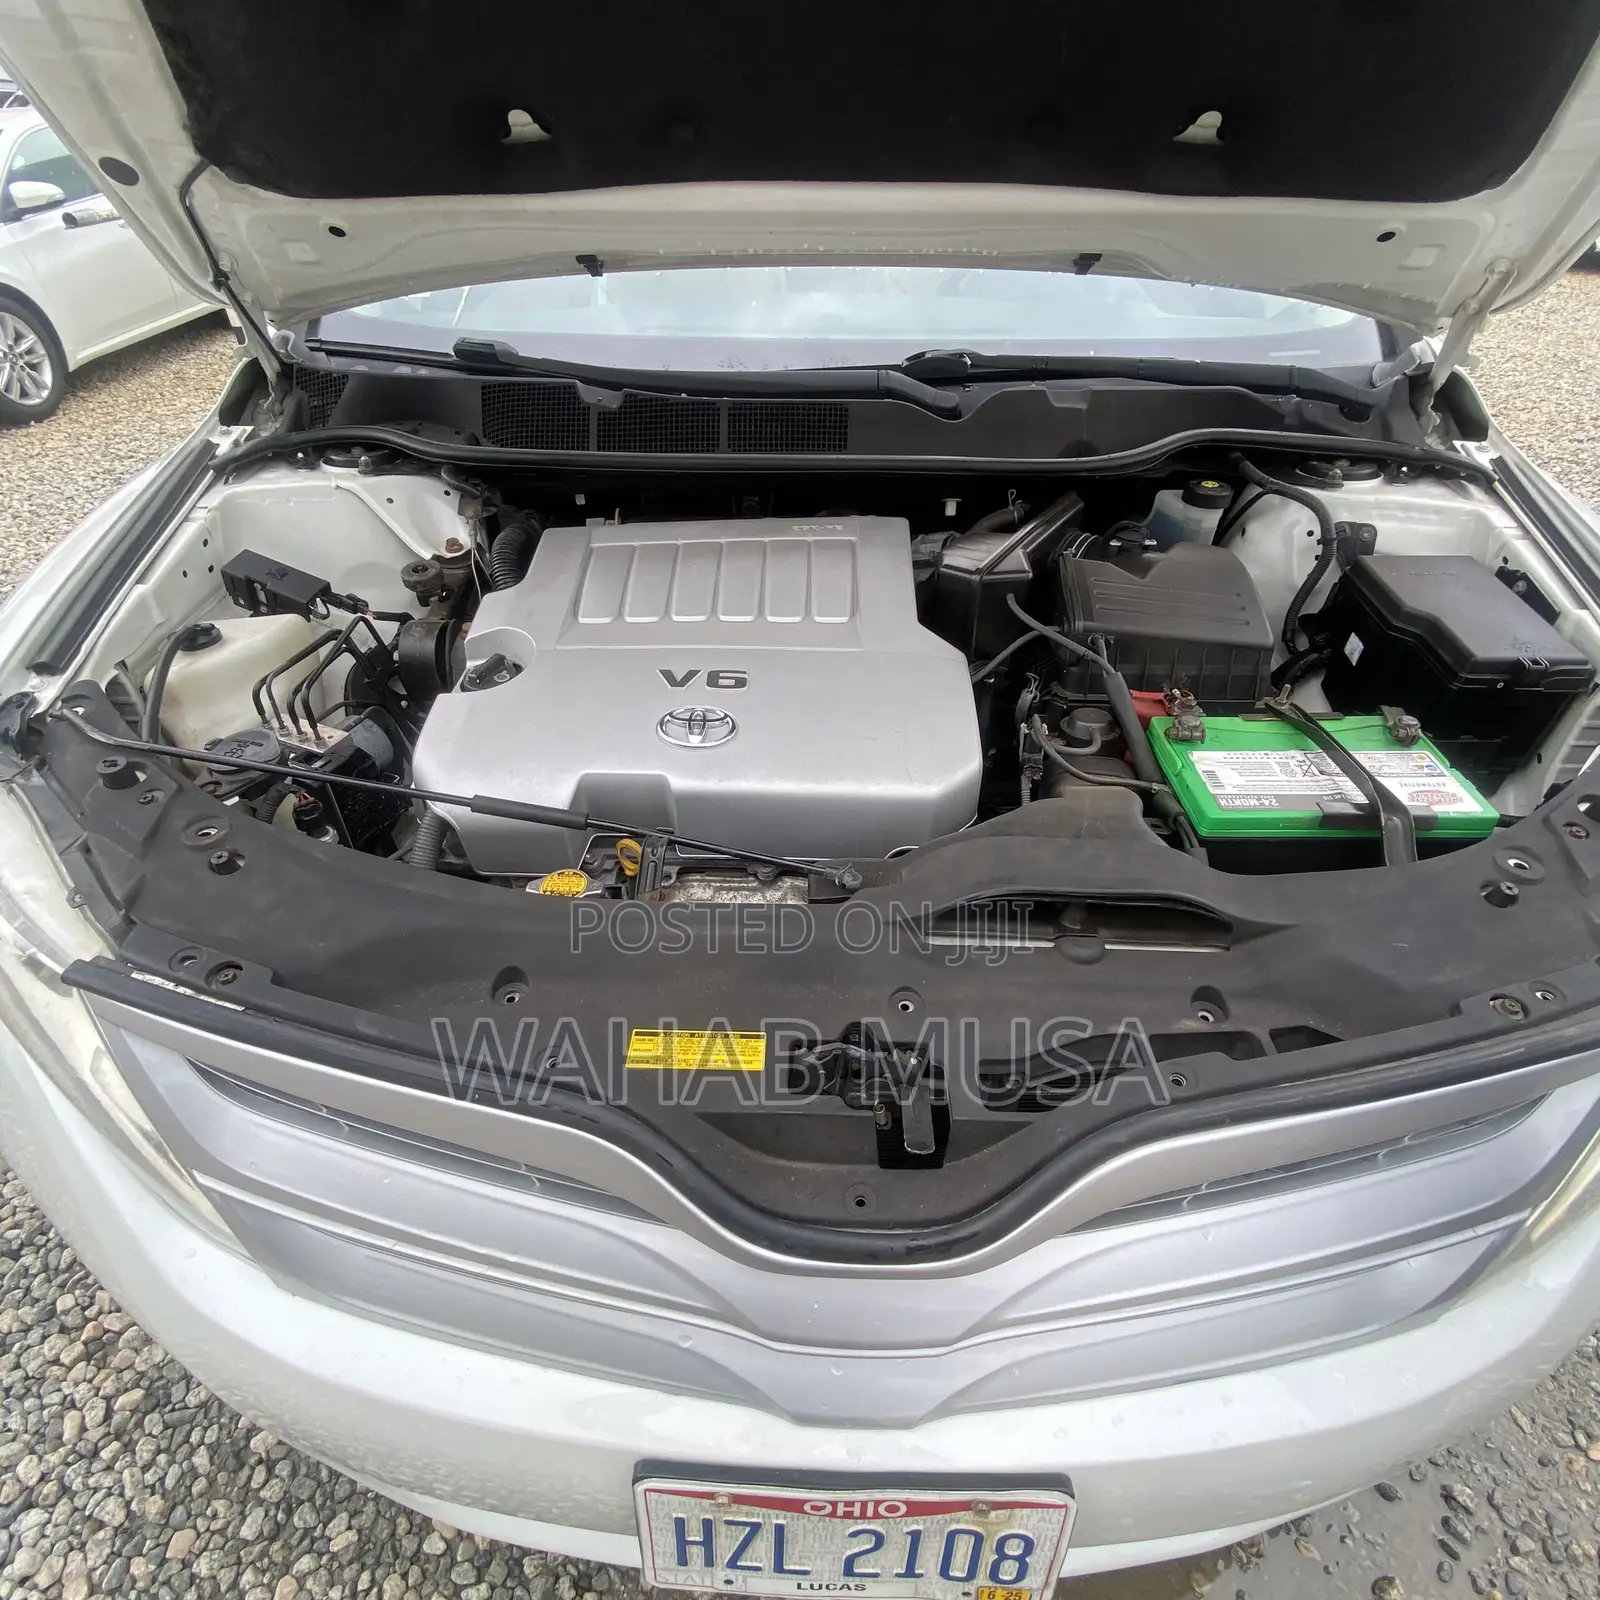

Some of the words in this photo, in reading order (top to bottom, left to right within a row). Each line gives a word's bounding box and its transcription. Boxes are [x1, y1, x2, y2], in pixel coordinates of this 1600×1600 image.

[656, 669, 749, 690] V6
[1218, 798, 1280, 807] 24-MONTH
[803, 1500, 908, 1518] OHIO
[880, 1518, 961, 1526] AVIATION
[673, 1516, 812, 1577] HZL
[842, 1528, 1035, 1585] 2108
[796, 1582, 867, 1592] LUCAS
[987, 1590, 997, 1600] 6
